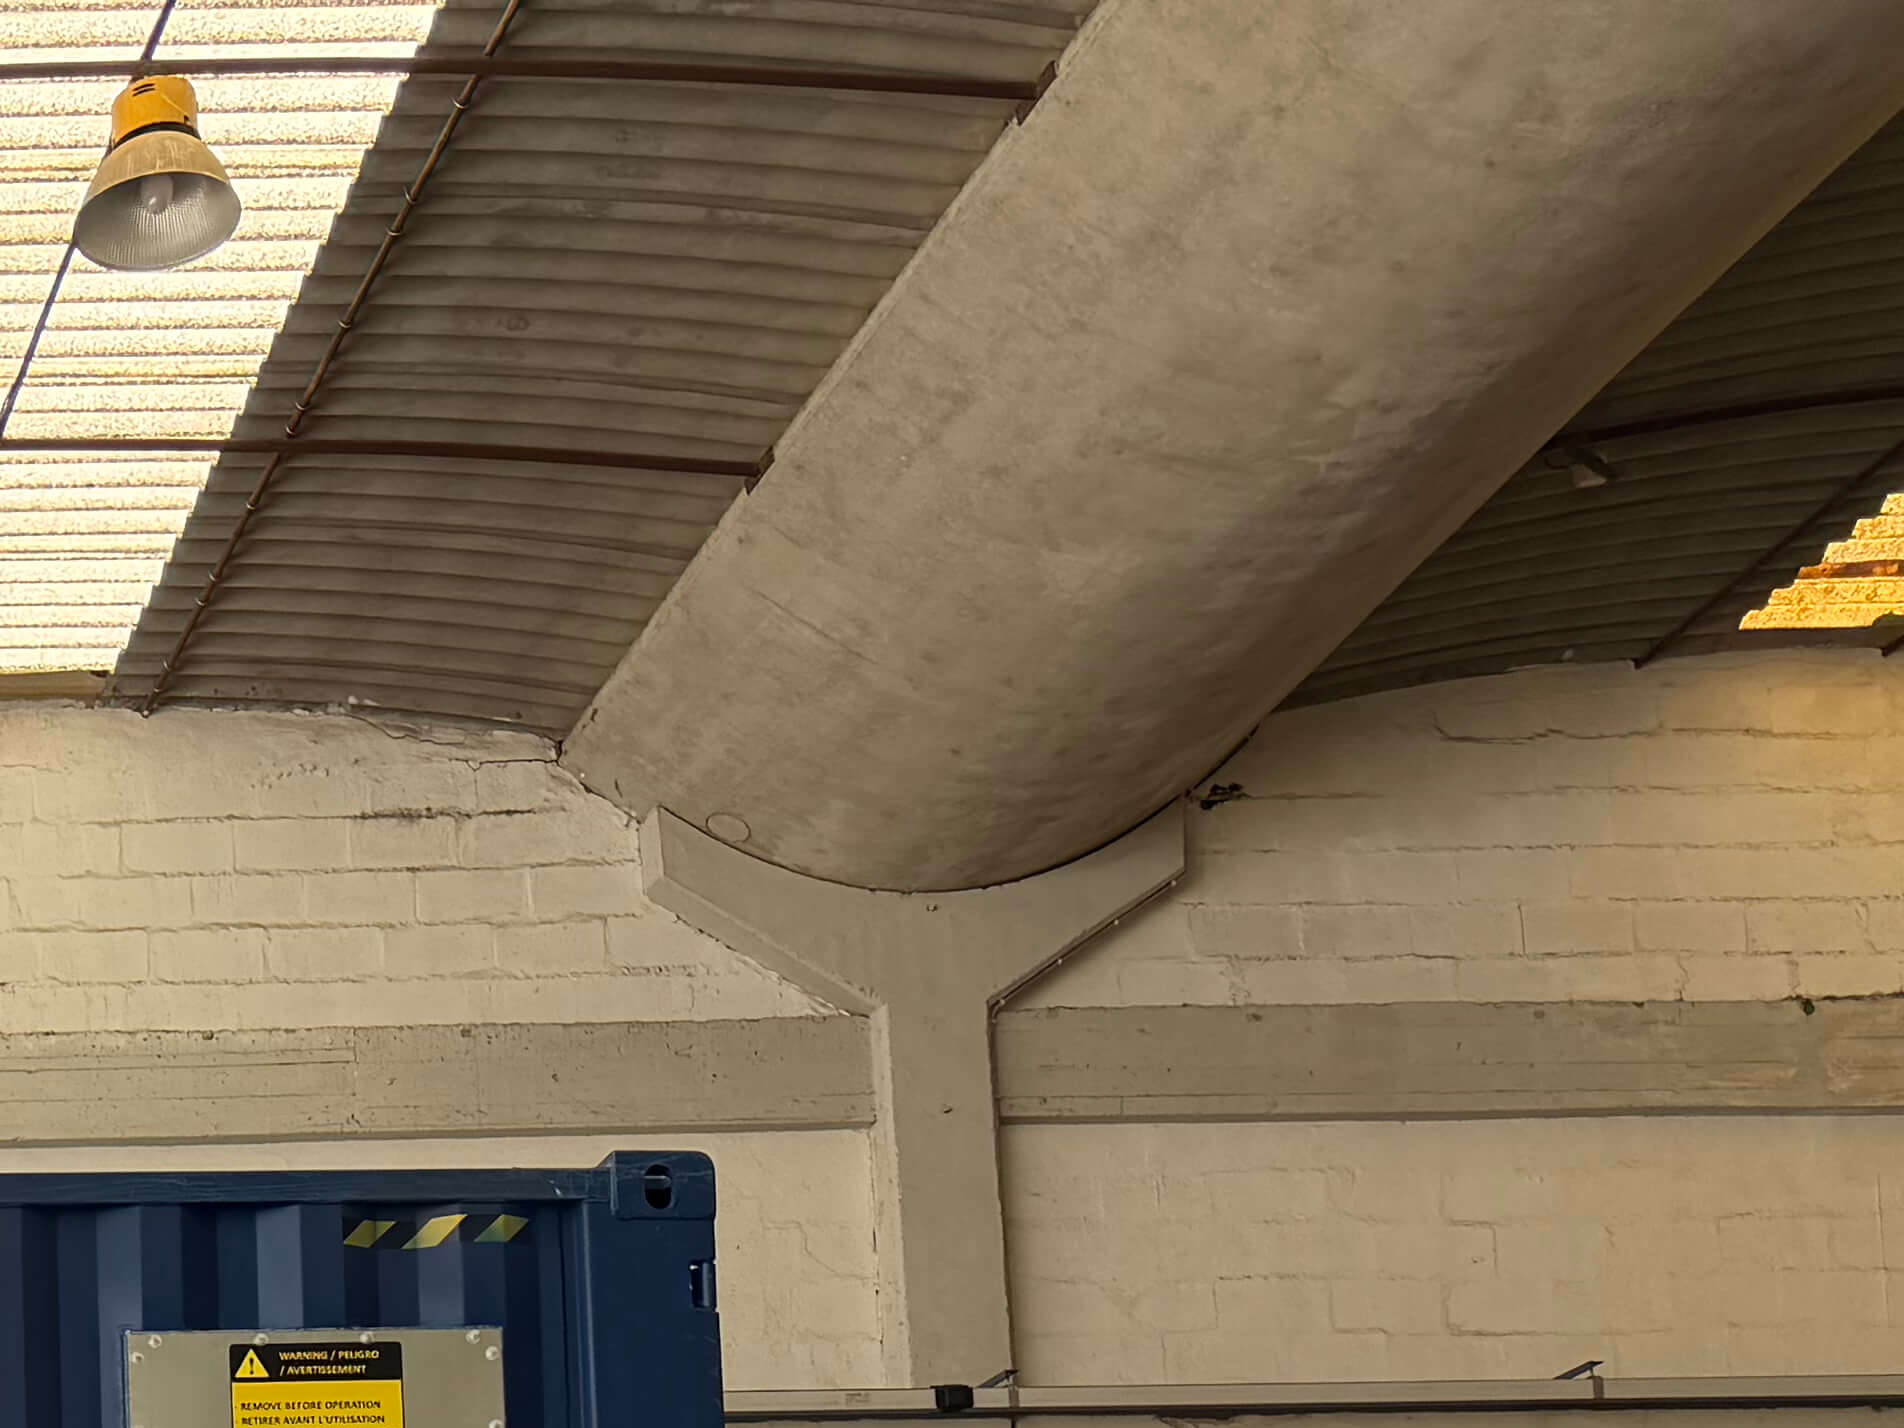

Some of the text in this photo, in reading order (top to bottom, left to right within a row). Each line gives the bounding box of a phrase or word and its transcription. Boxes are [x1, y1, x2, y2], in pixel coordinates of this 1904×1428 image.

[279, 1351, 328, 1360] WARNING
[338, 1350, 380, 1360] PELIGRO
[287, 1365, 366, 1375] AVERTISSEMENT
[240, 1400, 381, 1411] REMOVE BEFORE OPERATION
[241, 1416, 281, 1425] RETIRER
[283, 1416, 316, 1424] AVANT
